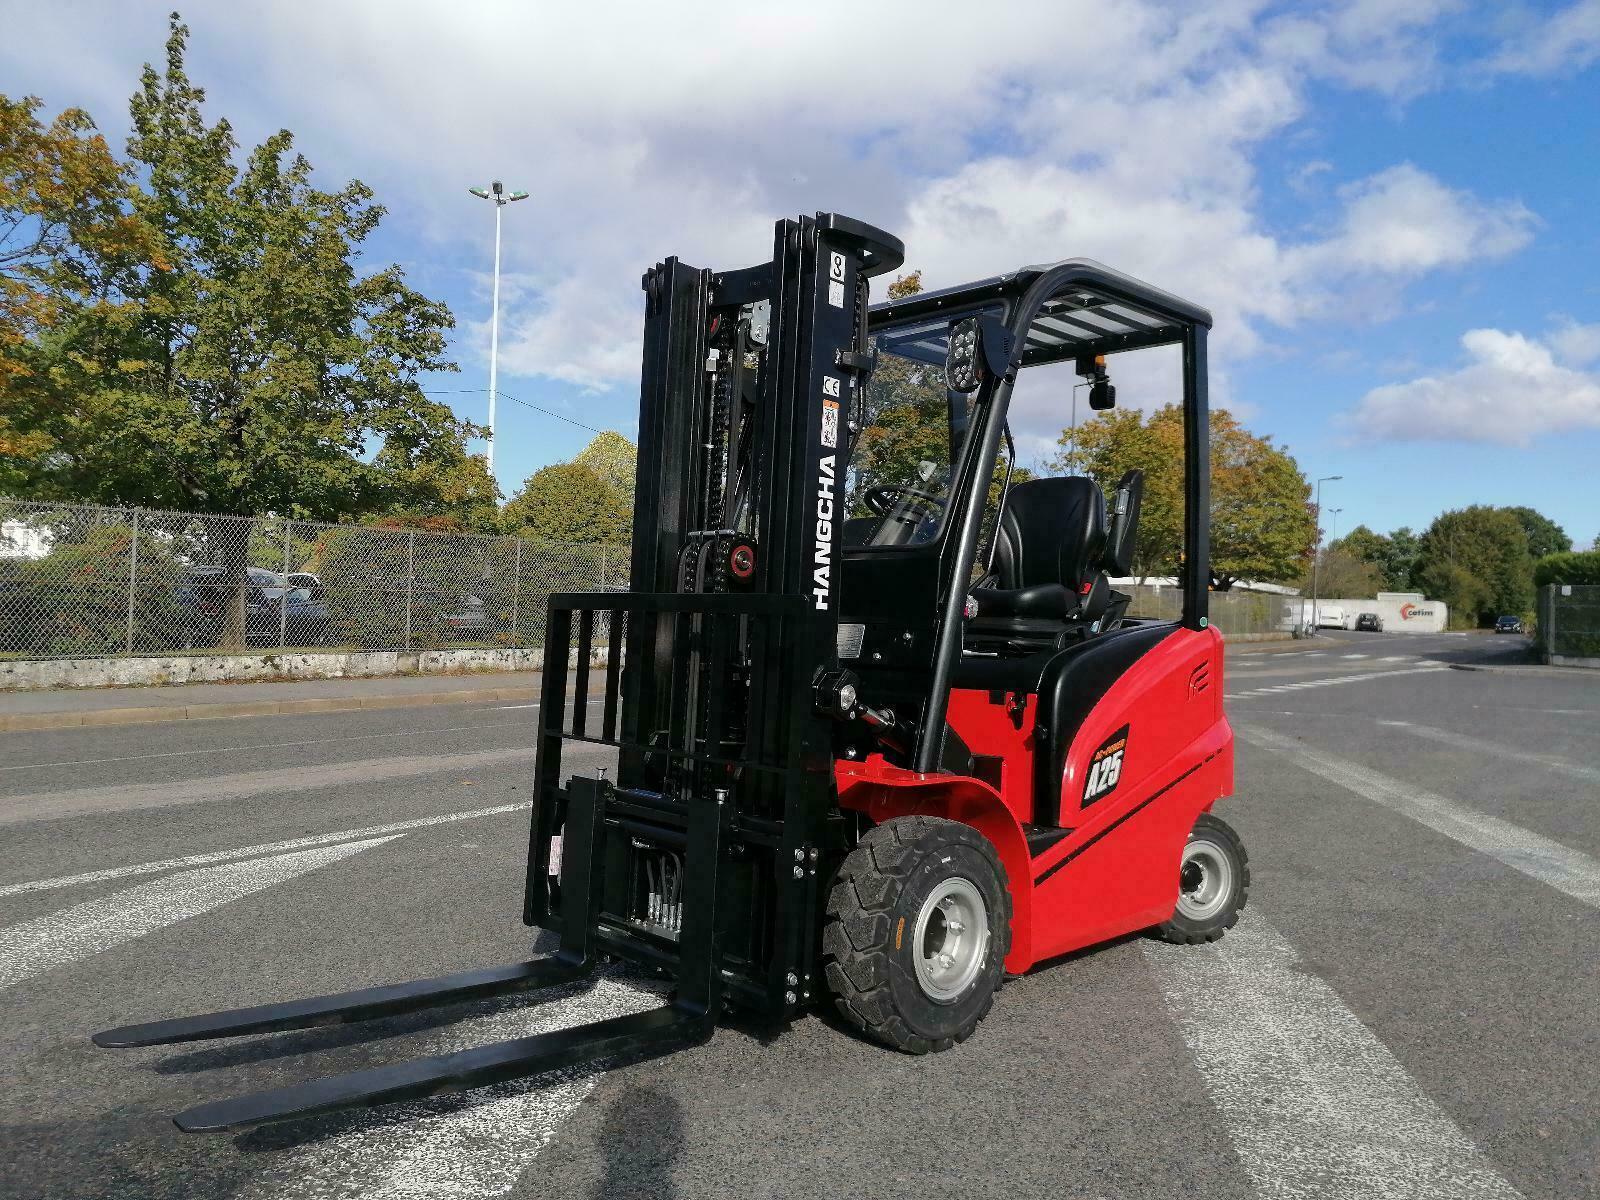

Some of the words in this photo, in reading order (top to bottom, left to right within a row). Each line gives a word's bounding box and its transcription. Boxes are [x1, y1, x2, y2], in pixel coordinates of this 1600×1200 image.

[825, 379, 839, 395] CE
[813, 455, 836, 611] HANGCHA
[1408, 609, 1433, 617] cetim
[1084, 750, 1124, 800] A25
